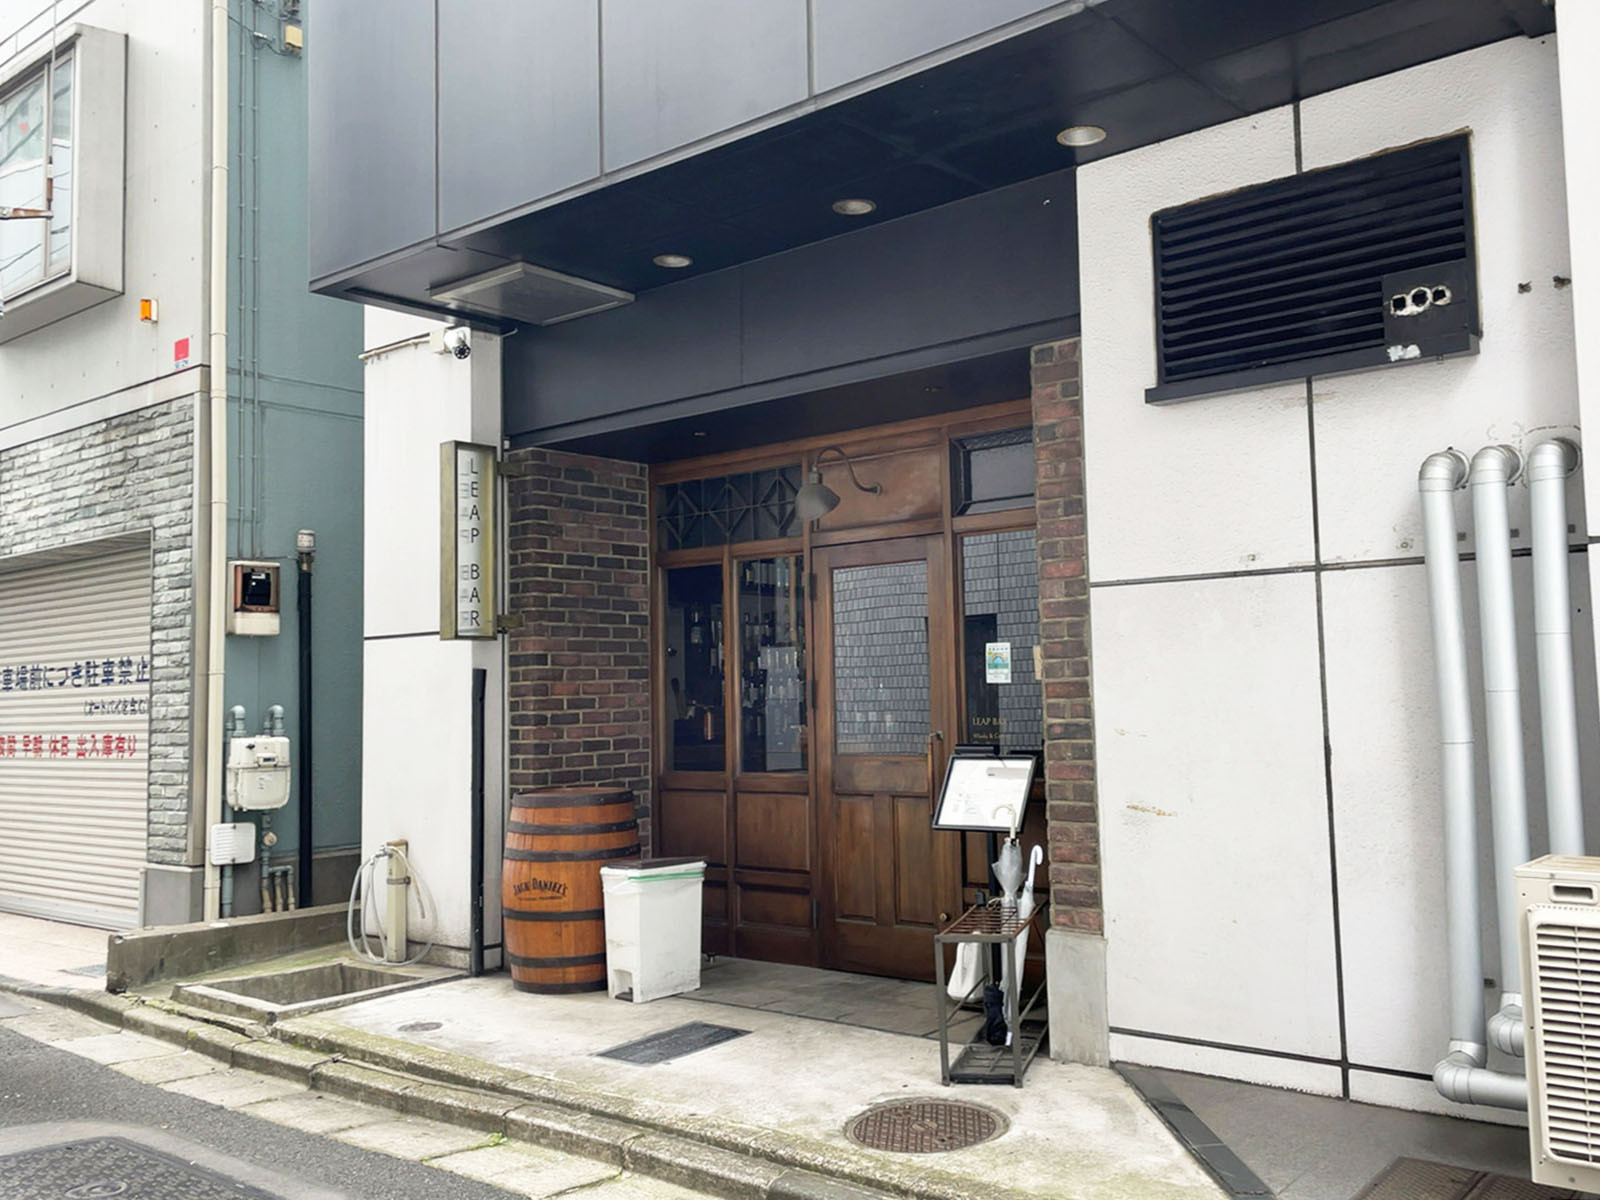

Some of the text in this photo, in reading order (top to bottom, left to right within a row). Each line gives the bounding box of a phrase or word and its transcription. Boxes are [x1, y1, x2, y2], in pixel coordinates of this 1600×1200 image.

[469, 458, 481, 627] LEAP BAR
[0, 656, 149, 691] 車場前につき駐車禁止
[49, 733, 70, 760] 休日
[513, 880, 531, 896] JACK
